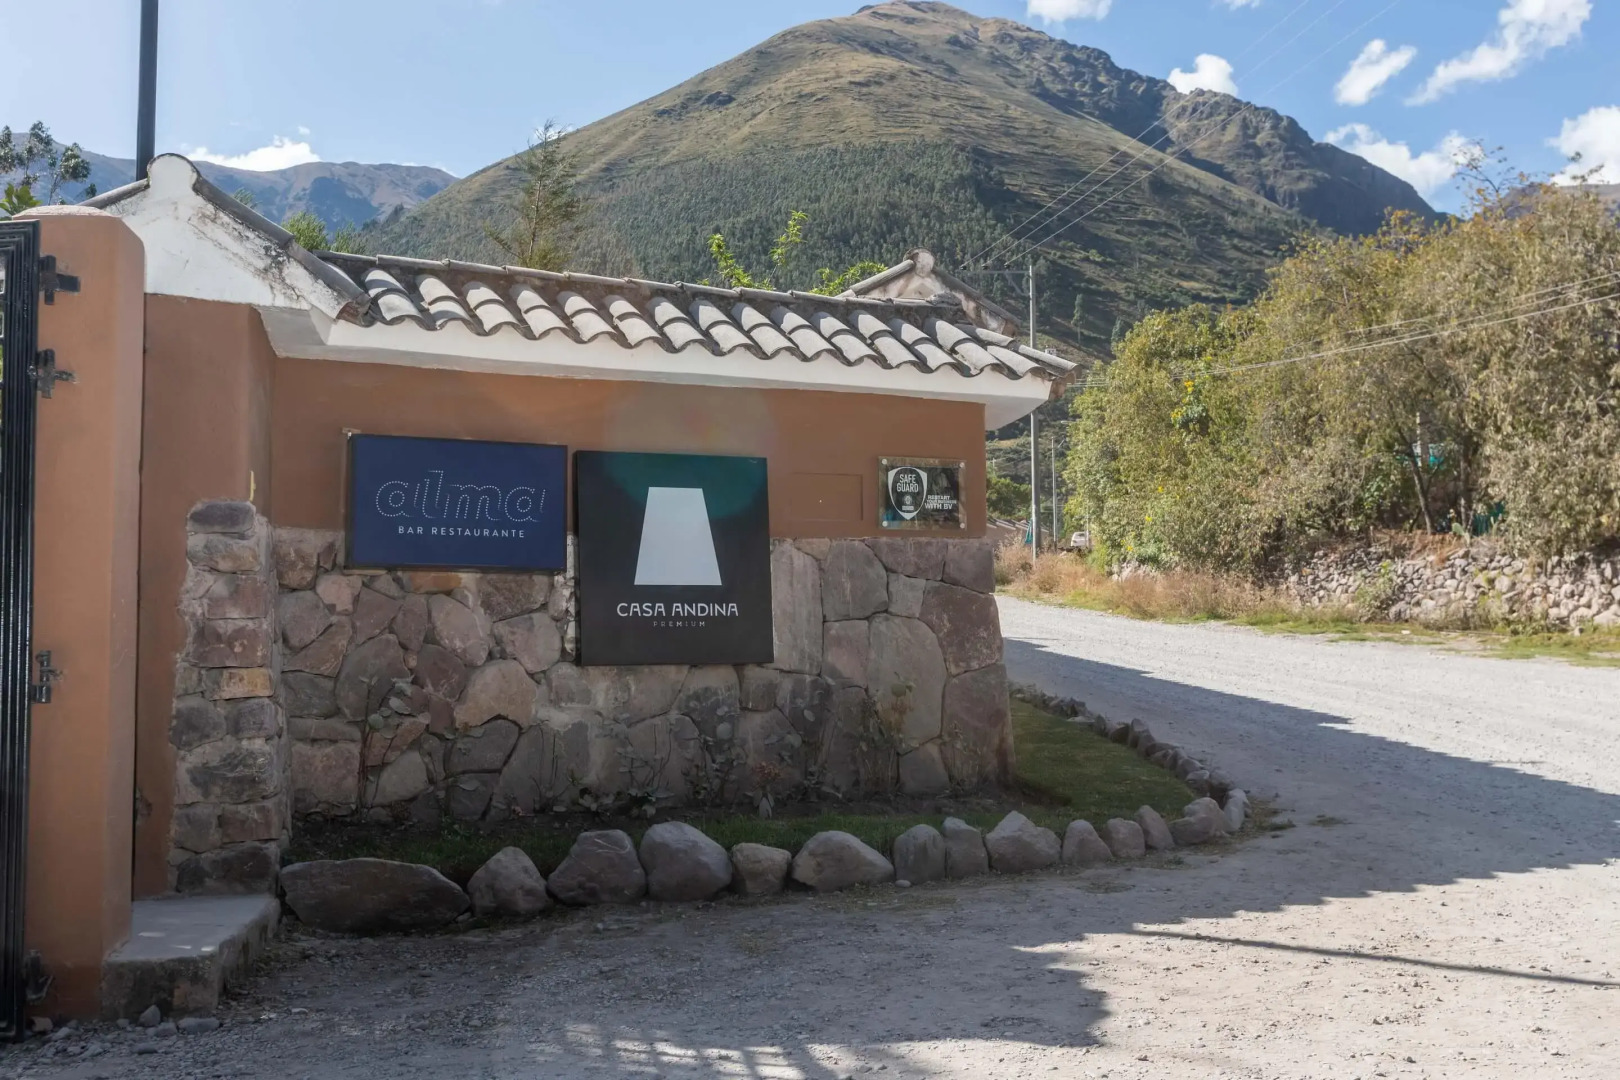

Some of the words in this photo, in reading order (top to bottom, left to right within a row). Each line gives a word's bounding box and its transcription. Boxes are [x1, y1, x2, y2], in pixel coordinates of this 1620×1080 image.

[900, 474, 916, 484] SAFE
[897, 483, 918, 493] GUARD
[376, 470, 546, 522] alma
[398, 526, 424, 535] BAR
[431, 527, 525, 538] RESTAURANTE
[617, 603, 666, 616] CASA
[672, 603, 738, 616] ANDINA
